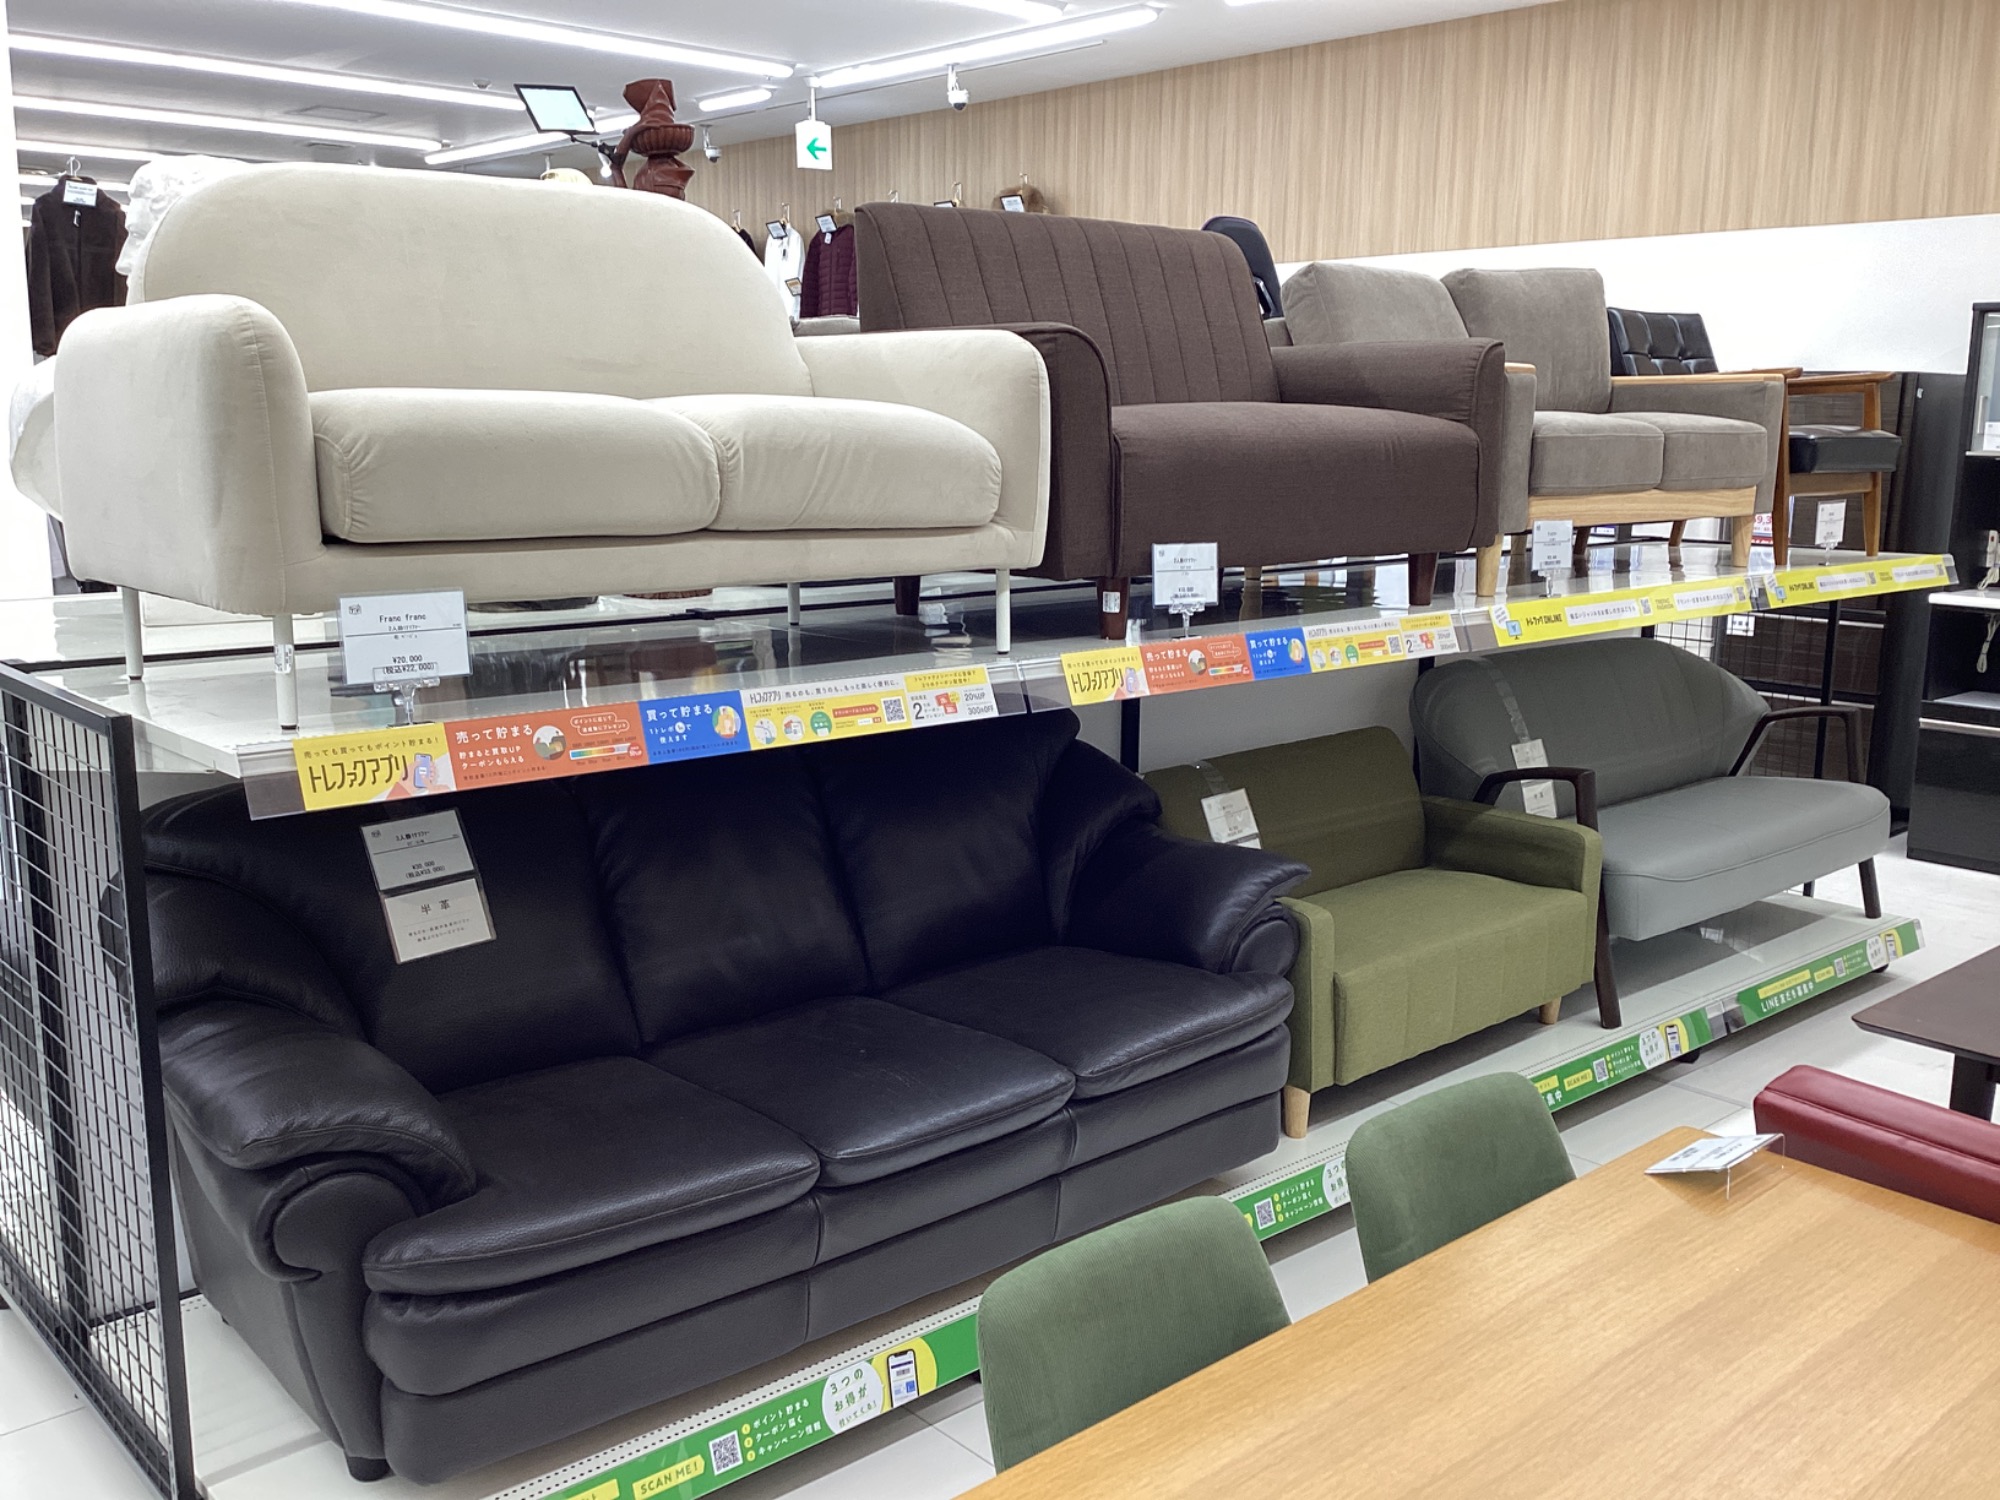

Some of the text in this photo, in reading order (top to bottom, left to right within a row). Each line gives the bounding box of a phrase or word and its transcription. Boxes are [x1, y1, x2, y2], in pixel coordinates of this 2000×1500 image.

[379, 614, 401, 623] Franc
[646, 704, 713, 722] 買って貯まる
[912, 702, 925, 720] 2
[456, 724, 534, 744] 売って貯まる
[660, 734, 688, 744] 使えます
[459, 745, 522, 760] 貯まると買取UP
[462, 756, 524, 770] クーポンもらえる
[308, 754, 409, 794] トレファクアプリ
[830, 1368, 864, 1395] 3つの
[835, 1383, 867, 1412] お得が
[753, 1398, 810, 1429] ポイント貯まる
[756, 1414, 802, 1443] クーポン届く
[758, 1420, 822, 1456] キャンペーン情報
[640, 1472, 672, 1495] SCAN
